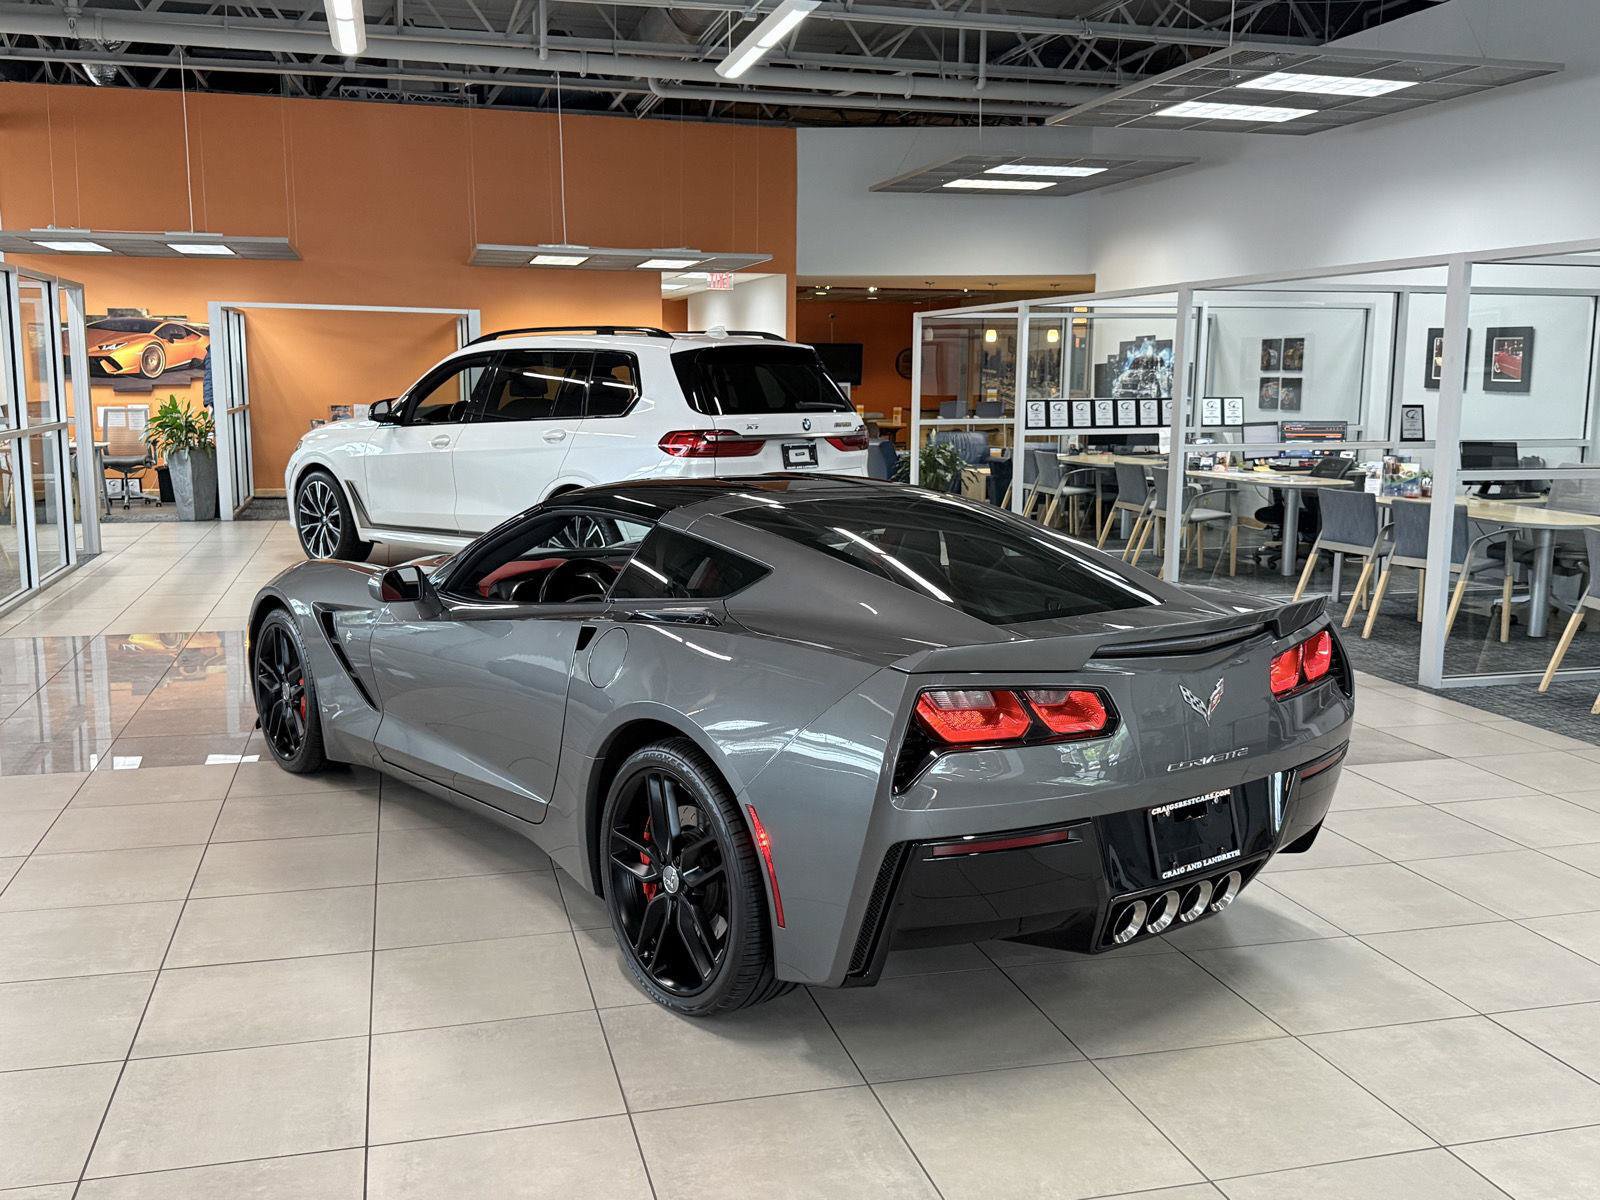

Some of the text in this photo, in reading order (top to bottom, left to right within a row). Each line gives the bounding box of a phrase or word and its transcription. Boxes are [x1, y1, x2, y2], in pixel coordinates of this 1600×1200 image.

[1166, 747, 1248, 772] CORVETTE
[1151, 788, 1231, 815] CRAIGSBESTCARS.COM
[1162, 849, 1241, 879] CRAIG AND LANDRETH
